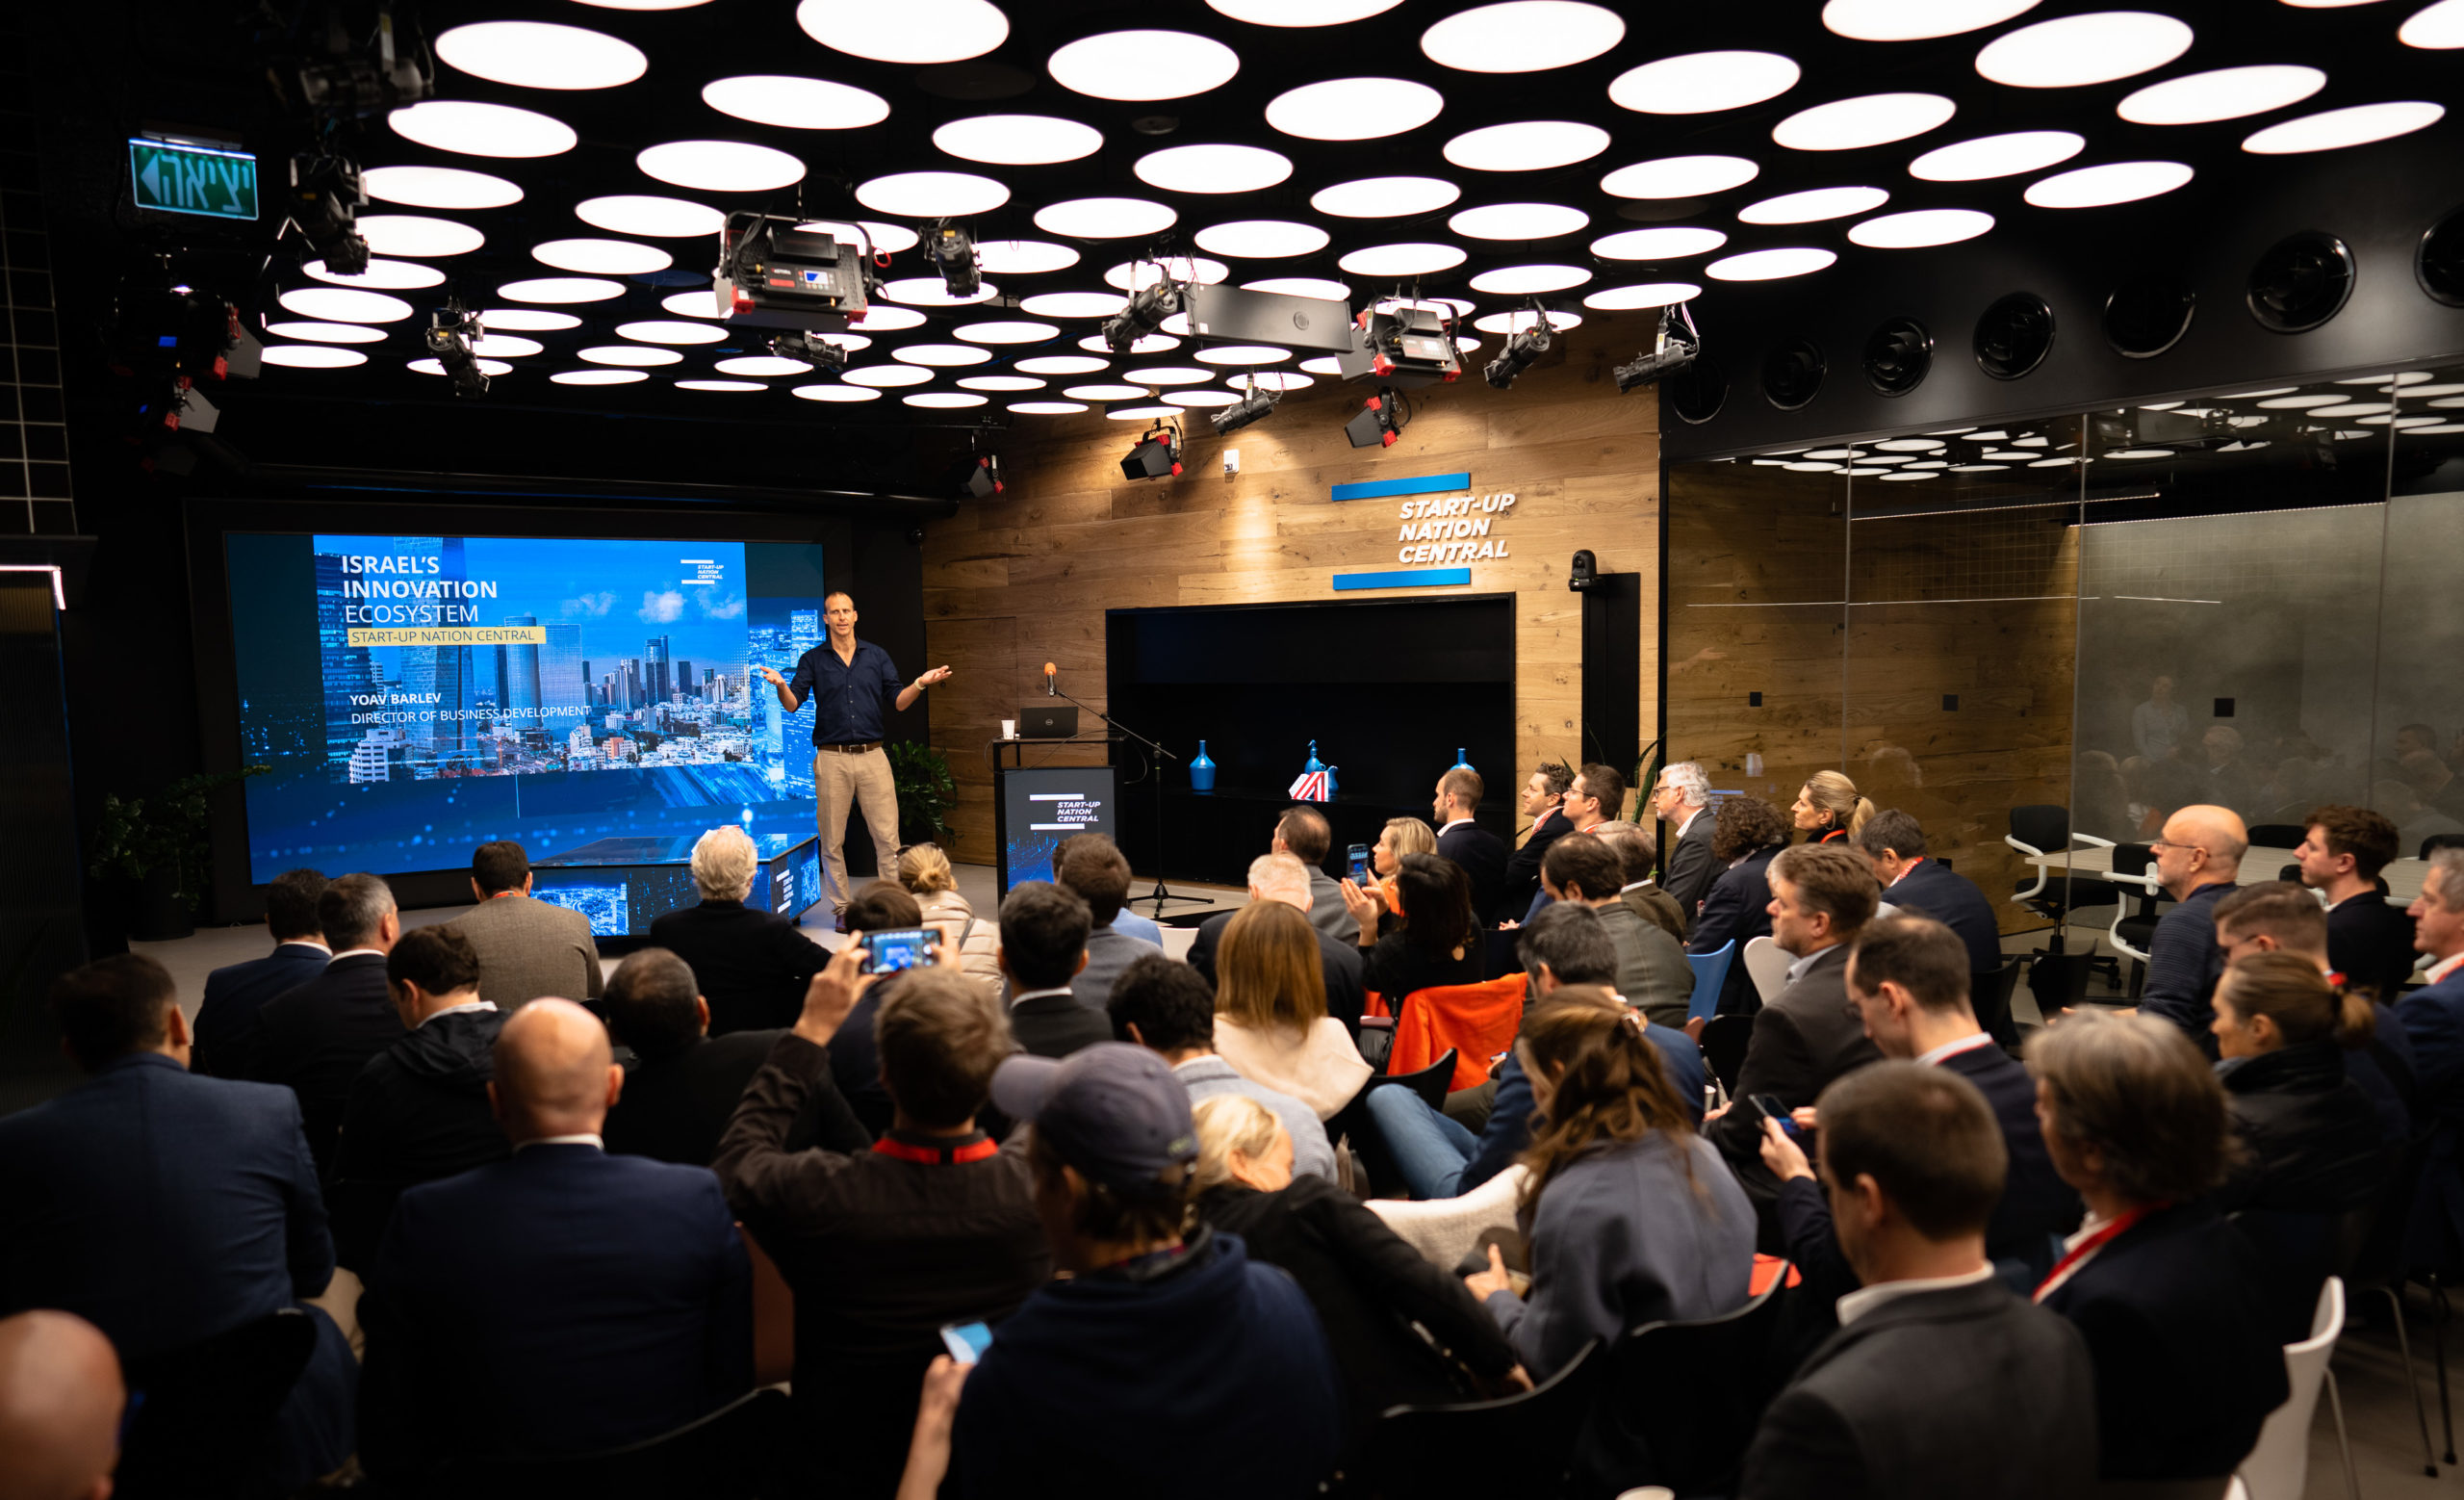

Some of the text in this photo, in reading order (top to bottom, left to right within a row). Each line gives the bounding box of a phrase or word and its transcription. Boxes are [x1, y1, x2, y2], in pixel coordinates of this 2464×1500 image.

[161, 154, 250, 213] יציאה
[1399, 494, 1515, 518] START-UP
[1399, 518, 1491, 542] NATION
[1399, 540, 1509, 563] CENTRAL
[342, 556, 440, 574] ISRAEL'S
[343, 580, 498, 599] INNOVATION
[346, 605, 478, 623] ECOSYSTEM
[351, 630, 535, 643] START-UP NATION CENTRAL
[349, 692, 442, 706] YOAV BARLEV
[351, 705, 591, 724] DIRECTOR OF BUSINESS DEVELOPMENT
